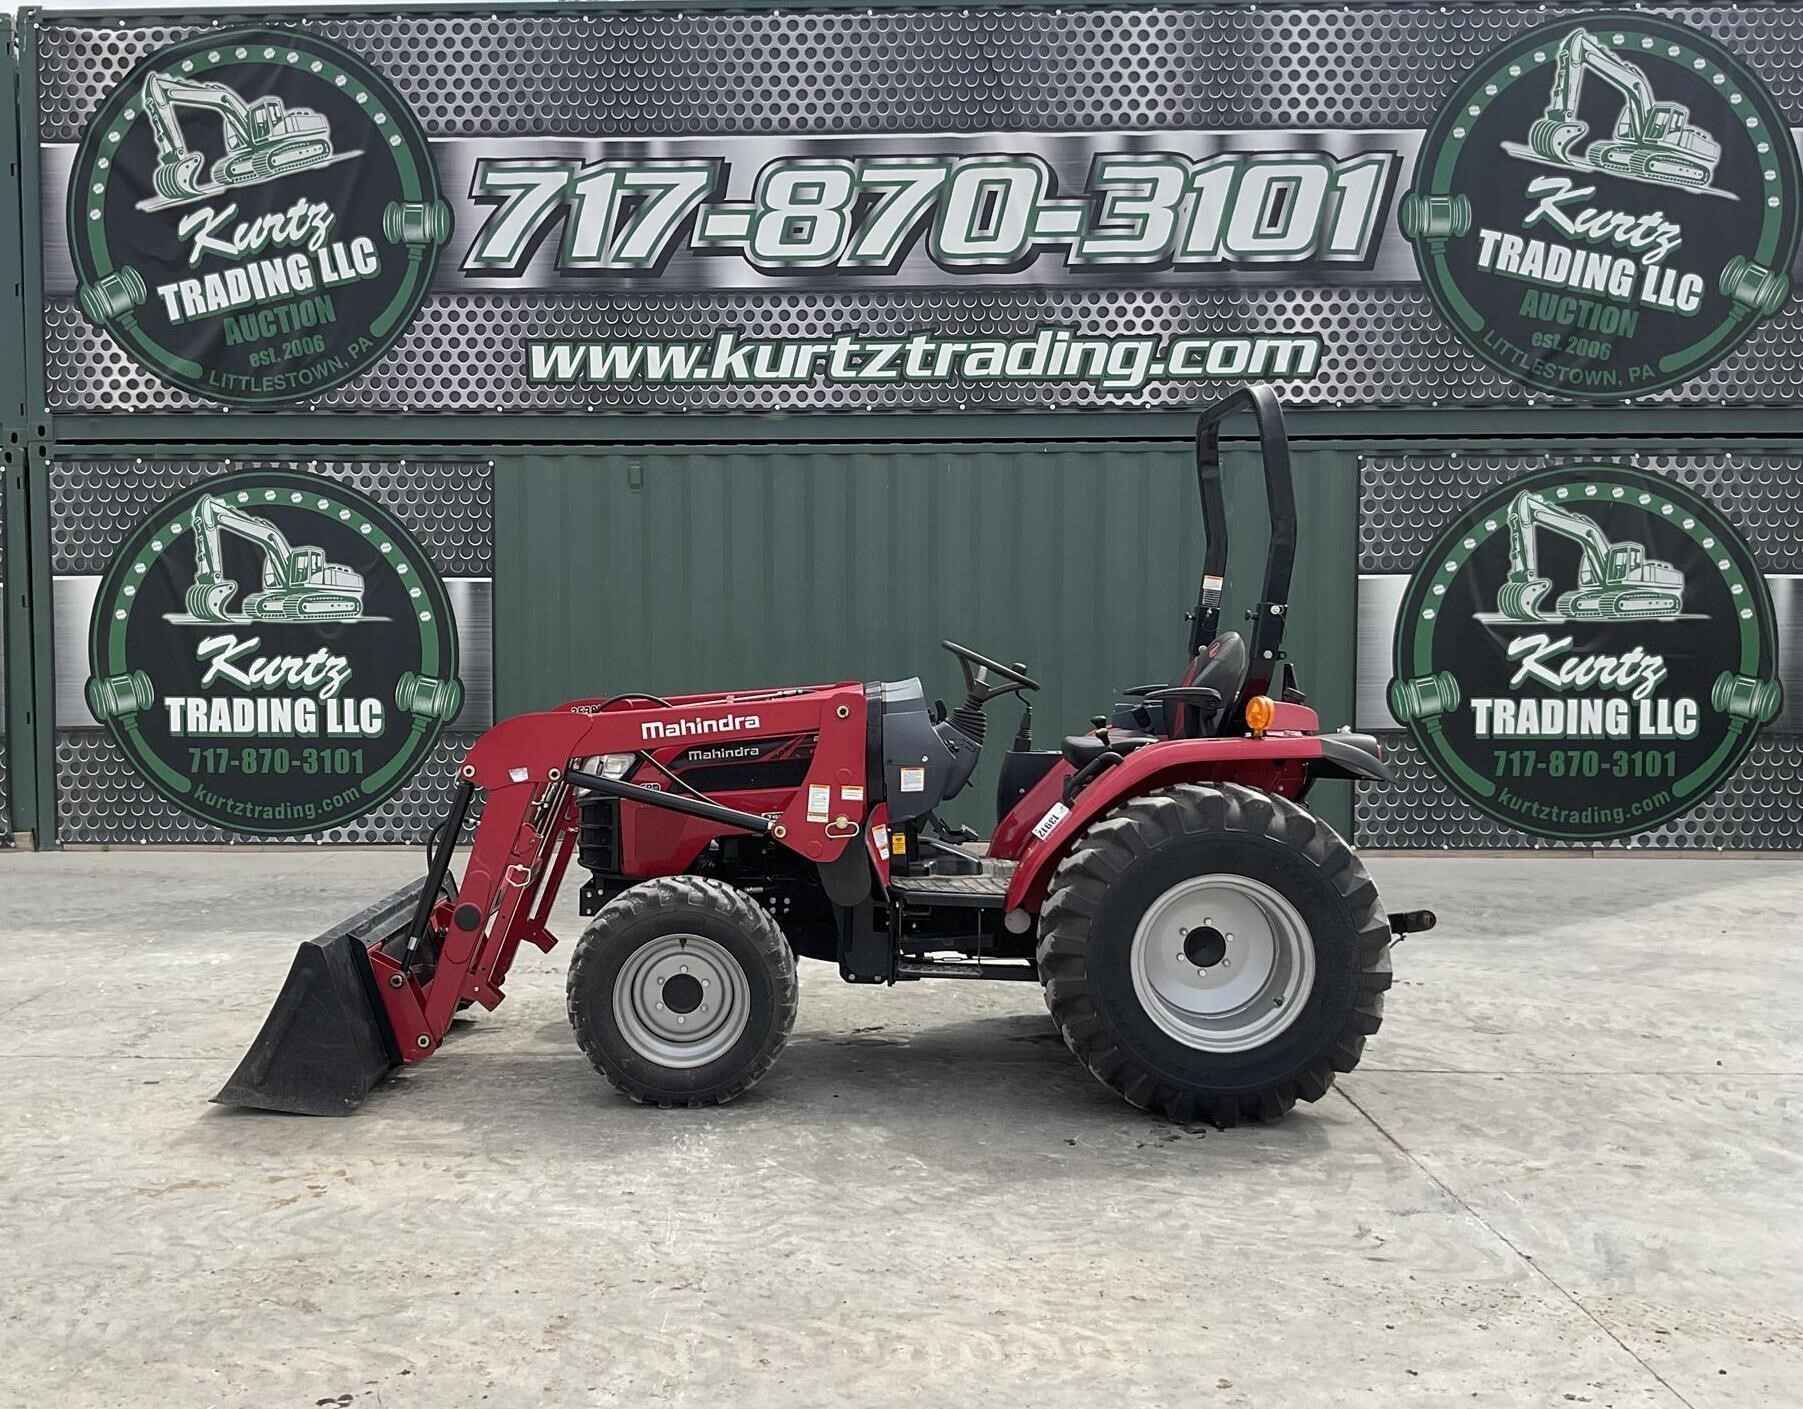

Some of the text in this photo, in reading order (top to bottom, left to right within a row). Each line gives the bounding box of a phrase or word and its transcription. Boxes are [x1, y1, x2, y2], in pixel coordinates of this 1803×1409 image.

[178, 197, 336, 266] Kurtz
[468, 153, 1392, 272] 717-870-3101
[1524, 176, 1683, 265] Kurtz
[157, 236, 380, 323] TRADING LLC
[1477, 227, 1704, 312] TRADING LLC
[224, 294, 337, 346] AUCTION
[1519, 289, 1640, 339] AUCTION
[282, 335, 326, 361] 2006
[348, 336, 375, 359] PA
[526, 329, 1321, 391] www.kurtztrading.com
[1566, 335, 1613, 362] 2006
[1628, 363, 1657, 383] PA
[196, 634, 352, 699] Kurtz
[1507, 634, 1668, 700] Kurtz
[163, 697, 386, 738] TRADING LLC
[640, 713, 761, 740] Mahindra
[1470, 698, 1700, 740] TRADING LLC
[188, 747, 364, 775] 717-870-3101
[688, 746, 760, 761] Mahindra
[1493, 750, 1676, 777] 717-870-3101
[193, 784, 360, 821] kurtztrading.com
[1498, 787, 1671, 825] kurtztrading.com
[1037, 814, 1060, 838] 13912
